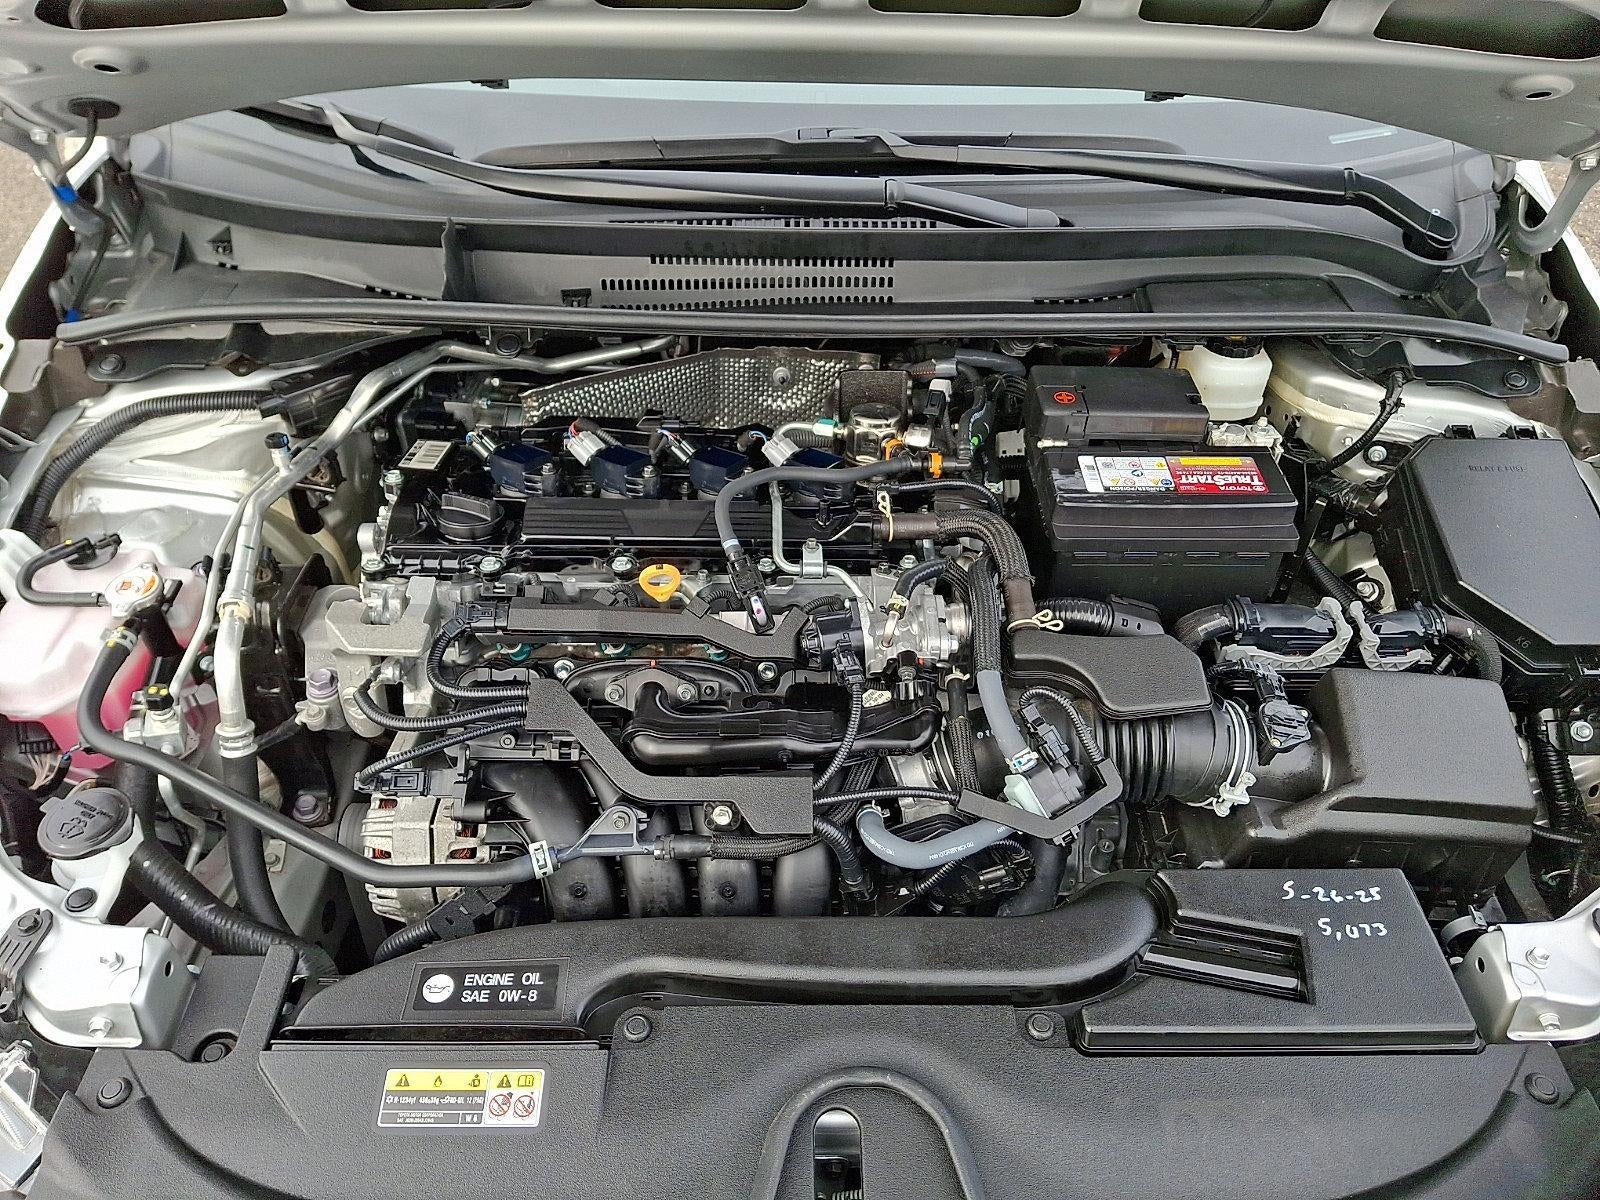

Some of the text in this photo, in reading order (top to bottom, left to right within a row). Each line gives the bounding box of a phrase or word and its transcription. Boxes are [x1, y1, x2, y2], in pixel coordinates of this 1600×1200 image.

[463, 972, 544, 987] ENGINE OIL
[460, 989, 538, 1003] SAE 0W-8
